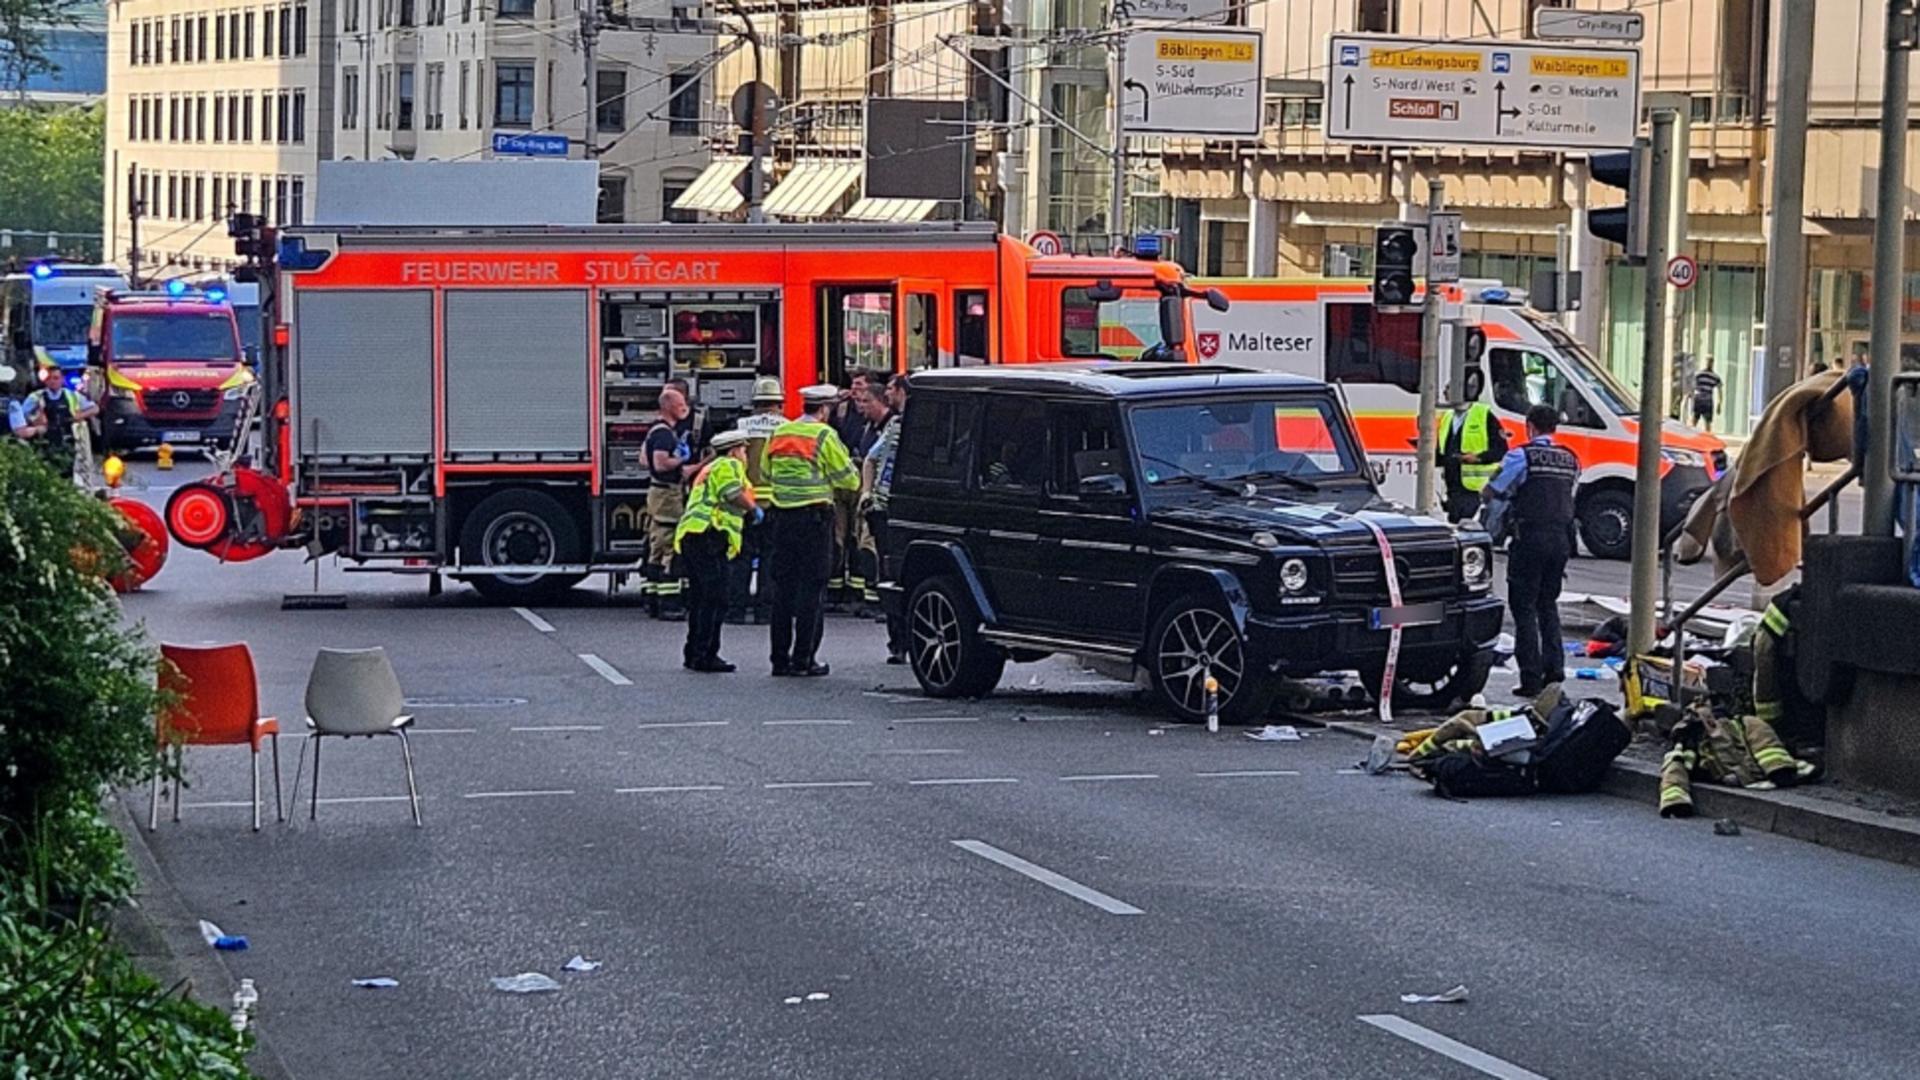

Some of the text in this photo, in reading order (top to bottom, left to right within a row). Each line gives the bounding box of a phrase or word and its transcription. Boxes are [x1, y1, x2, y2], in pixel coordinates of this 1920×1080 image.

[1140, 0, 1188, 13] City-Ring
[1578, 19, 1623, 32] City-Ring
[1160, 43, 1222, 59] Böblingen
[1401, 54, 1479, 70] Ludwigsburg
[1534, 59, 1599, 75] Waiblingen
[1156, 65, 1195, 78] S-Süd
[1156, 82, 1245, 98] Wilhelmsplatz
[1372, 77, 1456, 92] S-Nord/West
[1569, 85, 1619, 98] NeckarPark
[1392, 103, 1435, 115] Schloß
[1528, 103, 1562, 115] S-Ost
[1526, 121, 1597, 133] Kulturmeile
[402, 256, 720, 282] FEUERWEHR STUTTGART
[1672, 265, 1690, 279] 40
[1228, 332, 1313, 351] Malteser
